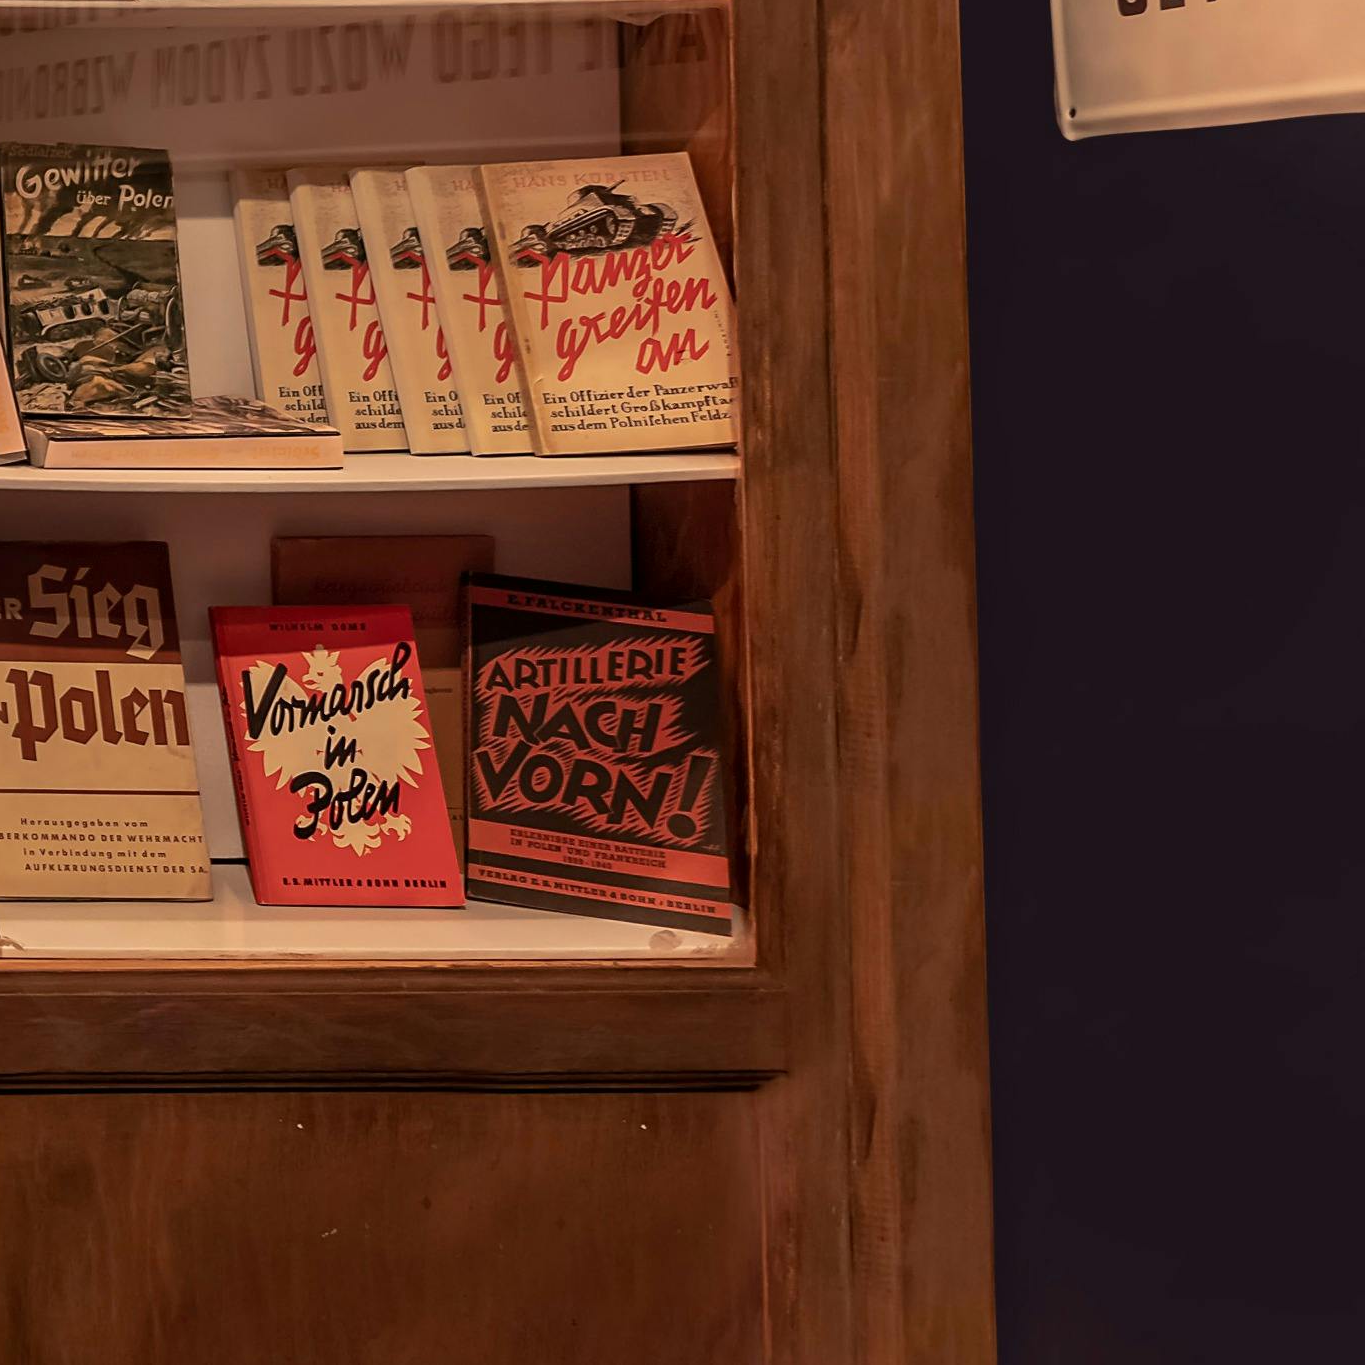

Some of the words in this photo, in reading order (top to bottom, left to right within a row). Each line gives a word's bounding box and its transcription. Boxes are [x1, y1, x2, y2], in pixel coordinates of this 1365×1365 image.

[15, 149, 141, 199] Gewitter
[76, 190, 111, 206] über
[118, 184, 173, 212] Polen
[555, 277, 718, 382] greifen
[635, 328, 710, 375] an
[542, 392, 567, 405] Ein
[569, 387, 624, 402] Offizier
[627, 385, 651, 399] der
[550, 404, 619, 418] schildert
[550, 423, 576, 433] aus
[576, 421, 607, 431] dem
[27, 564, 166, 661] Sieg
[241, 641, 412, 740] Vormarsch
[484, 646, 687, 692] ARTILLERIE
[5, 668, 191, 762] Polen
[492, 691, 664, 754] NACH
[323, 724, 358, 770] in
[289, 767, 401, 840] Polen
[475, 739, 715, 839] VORN!
[20, 817, 120, 829] Herausgegeben
[100, 834, 123, 843] DER
[127, 834, 204, 844] WEHRMACHT
[39, 848, 113, 860] Verbindung
[117, 849, 138, 858] mit
[141, 850, 167, 858] dem
[163, 865, 186, 874] DER
